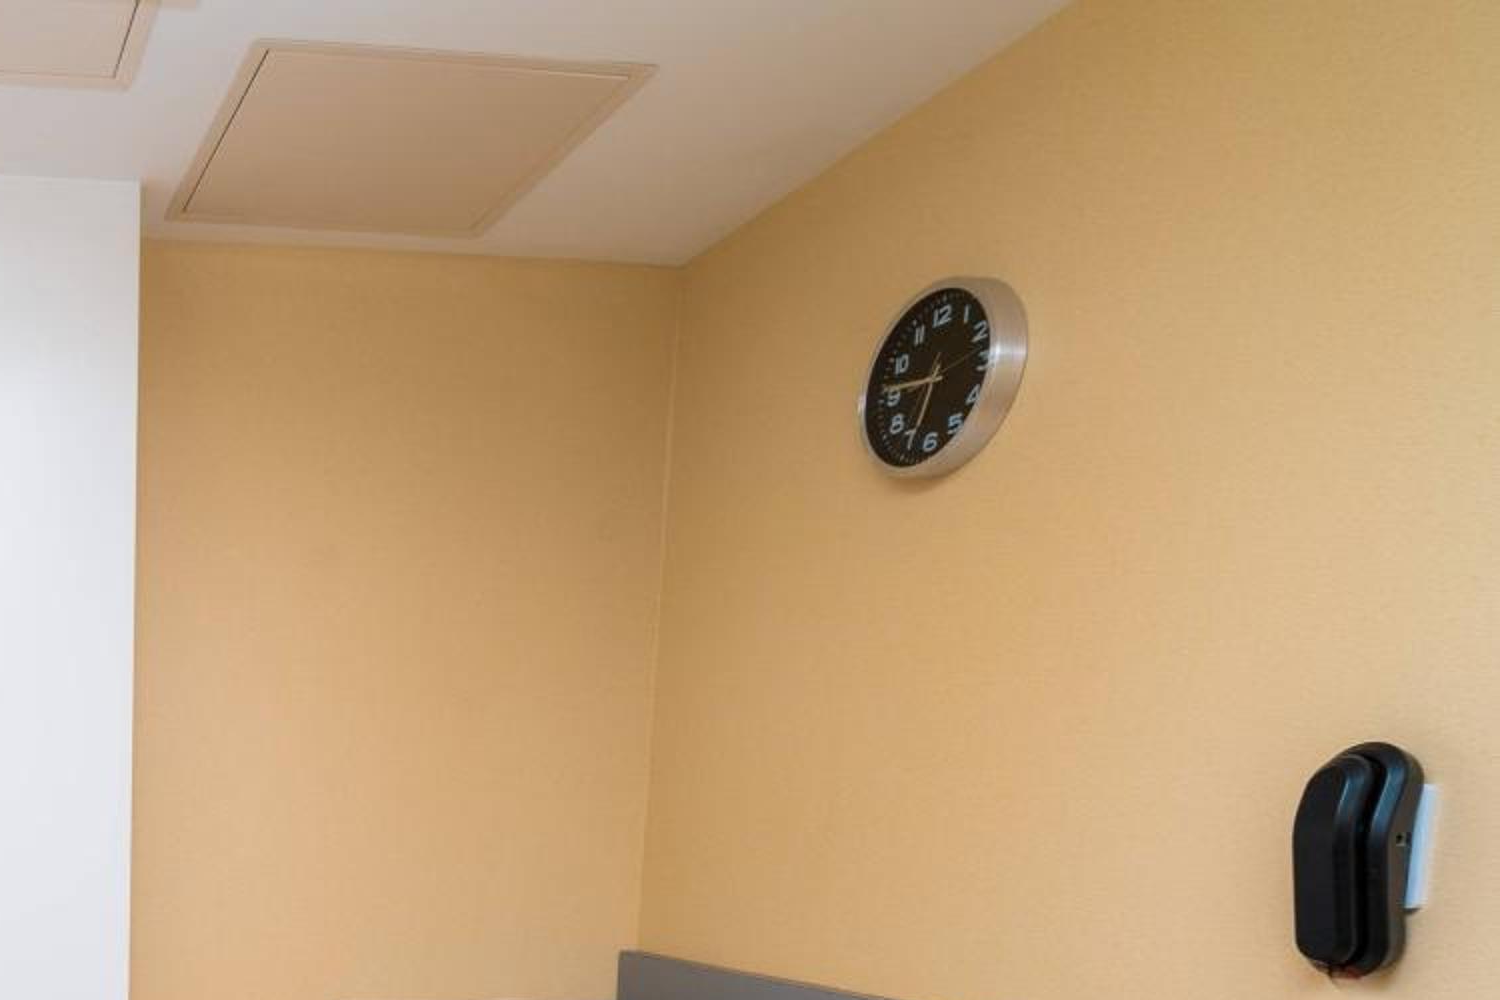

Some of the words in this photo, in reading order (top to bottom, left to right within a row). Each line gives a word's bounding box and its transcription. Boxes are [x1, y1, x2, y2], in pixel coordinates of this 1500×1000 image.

[932, 304, 953, 328] 12
[963, 304, 971, 325] 1
[914, 325, 926, 346] 11
[972, 320, 989, 343] 2
[895, 353, 910, 375] 10
[886, 387, 901, 407] 9
[965, 383, 981, 405] 4
[889, 413, 905, 434] 8
[947, 413, 964, 435] 5
[904, 428, 917, 450] 7
[922, 431, 938, 452] 6
